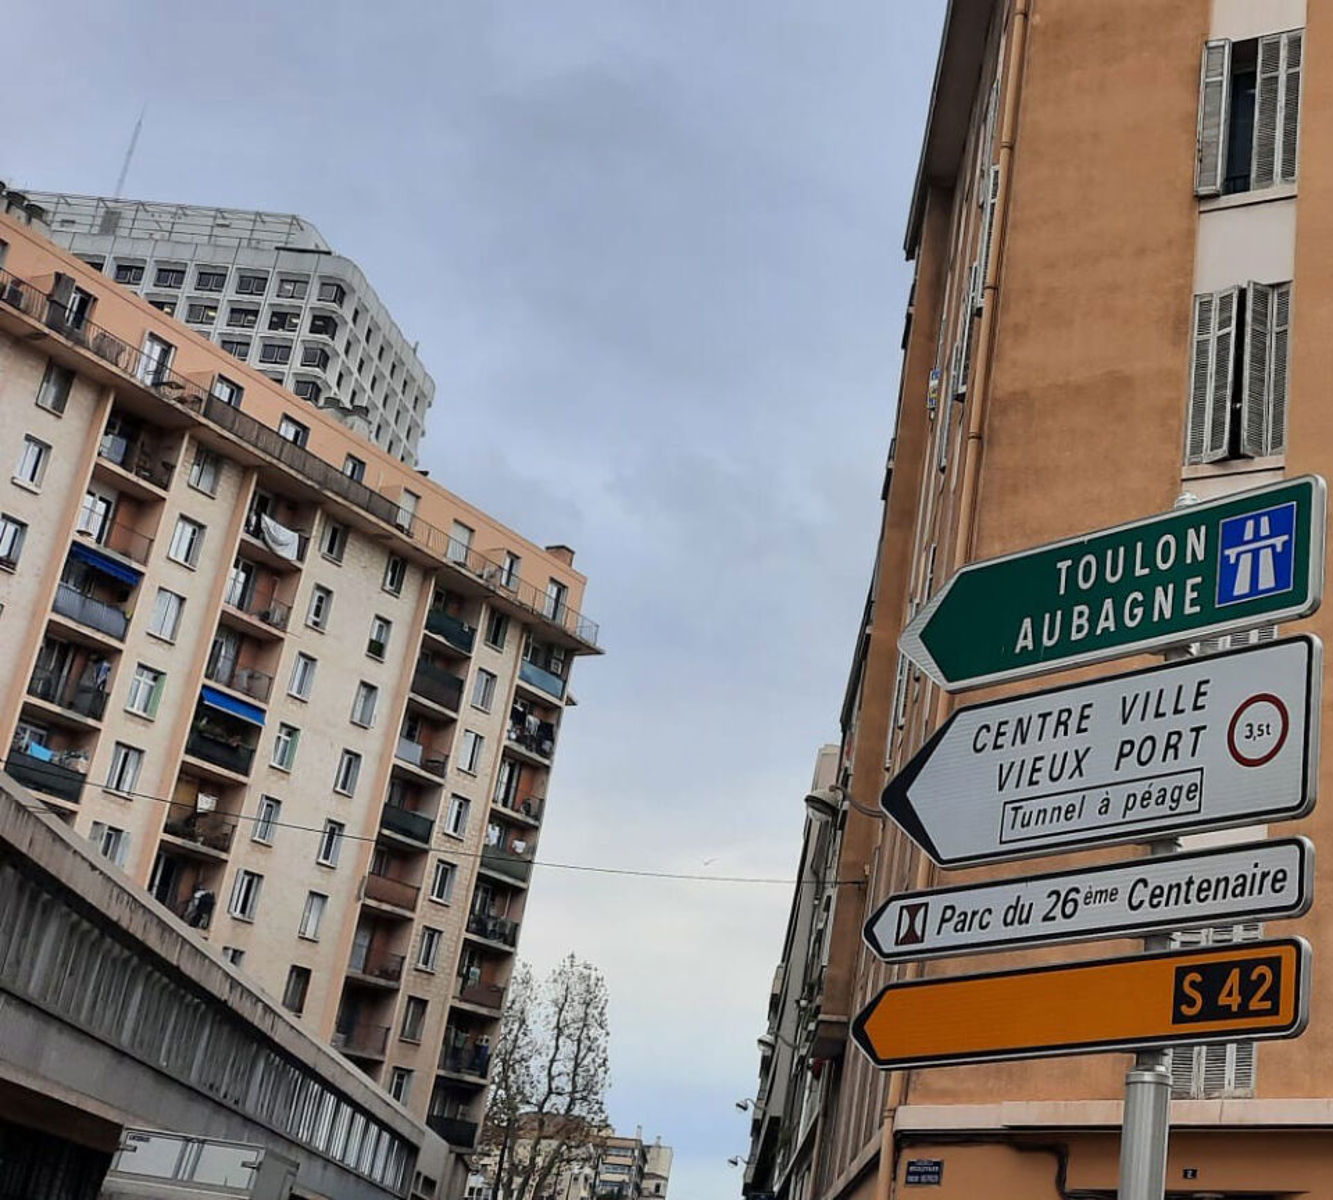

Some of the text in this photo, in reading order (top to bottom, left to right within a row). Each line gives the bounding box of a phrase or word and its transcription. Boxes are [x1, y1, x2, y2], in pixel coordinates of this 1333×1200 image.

[1056, 524, 1207, 596] TOULON
[1014, 577, 1202, 654] AUBAGNE
[973, 679, 1210, 754] CENTRE VILLE
[996, 726, 1207, 792] VIEUX PORT
[1009, 782, 1198, 830] Tunnel à péage
[936, 905, 992, 936] Parc
[1003, 895, 1033, 927] du
[1127, 862, 1288, 911] Centenaire
[1180, 965, 1273, 1016] S 42
